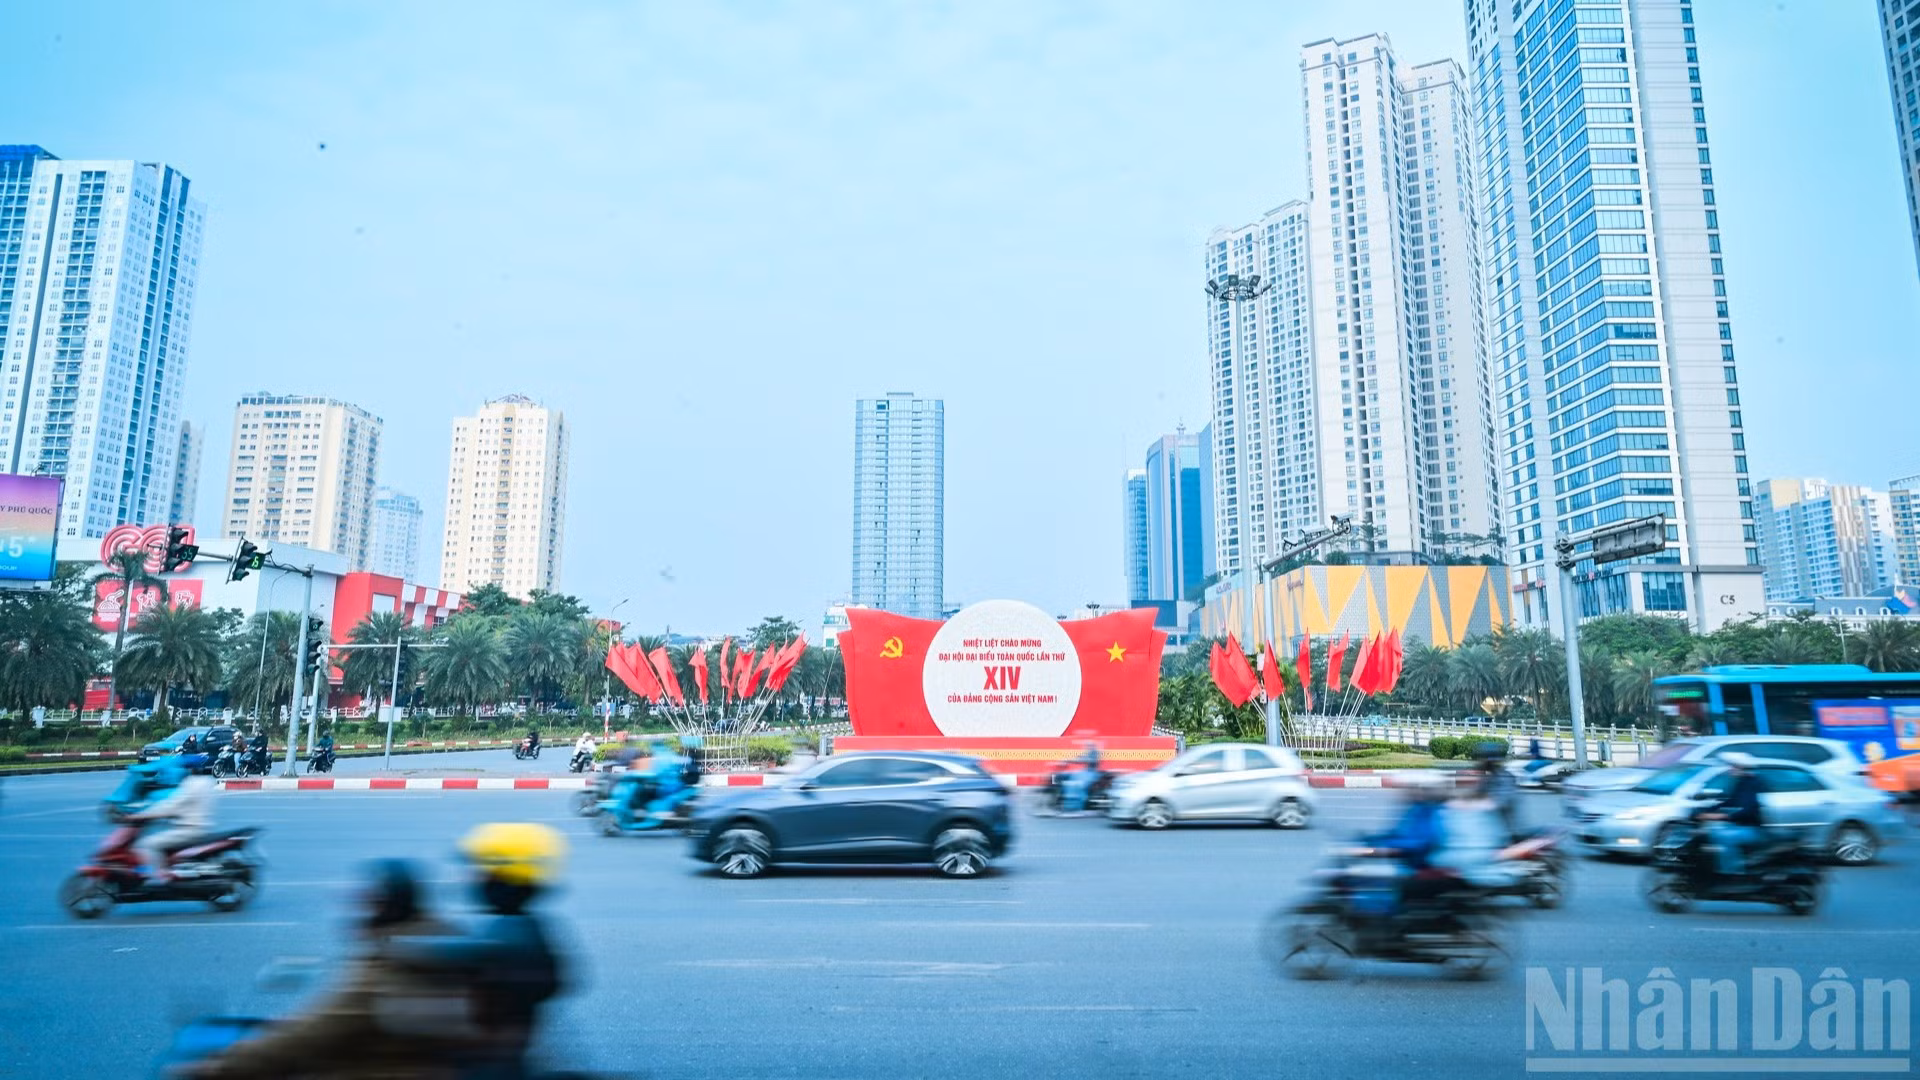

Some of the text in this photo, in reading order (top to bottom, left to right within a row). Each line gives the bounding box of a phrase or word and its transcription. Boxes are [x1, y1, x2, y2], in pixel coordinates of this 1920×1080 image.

[8, 504, 26, 513] PHÚ
[28, 506, 53, 515] QUỐC
[1720, 595, 1735, 605] C5
[963, 638, 1041, 648] NHIỆT LIỆT CHÀO MỪNG
[939, 650, 1065, 662] ĐẠI HỘI ĐẠI BIỂU TOÀN QUỐC LẦN THỨ
[984, 666, 1021, 690] XIV
[948, 693, 961, 703] CỦA
[963, 693, 982, 703] ĐẢNG
[984, 694, 1003, 704] CỘNG
[1005, 693, 1019, 703] SẢN
[1021, 694, 1035, 704] VIỆT
